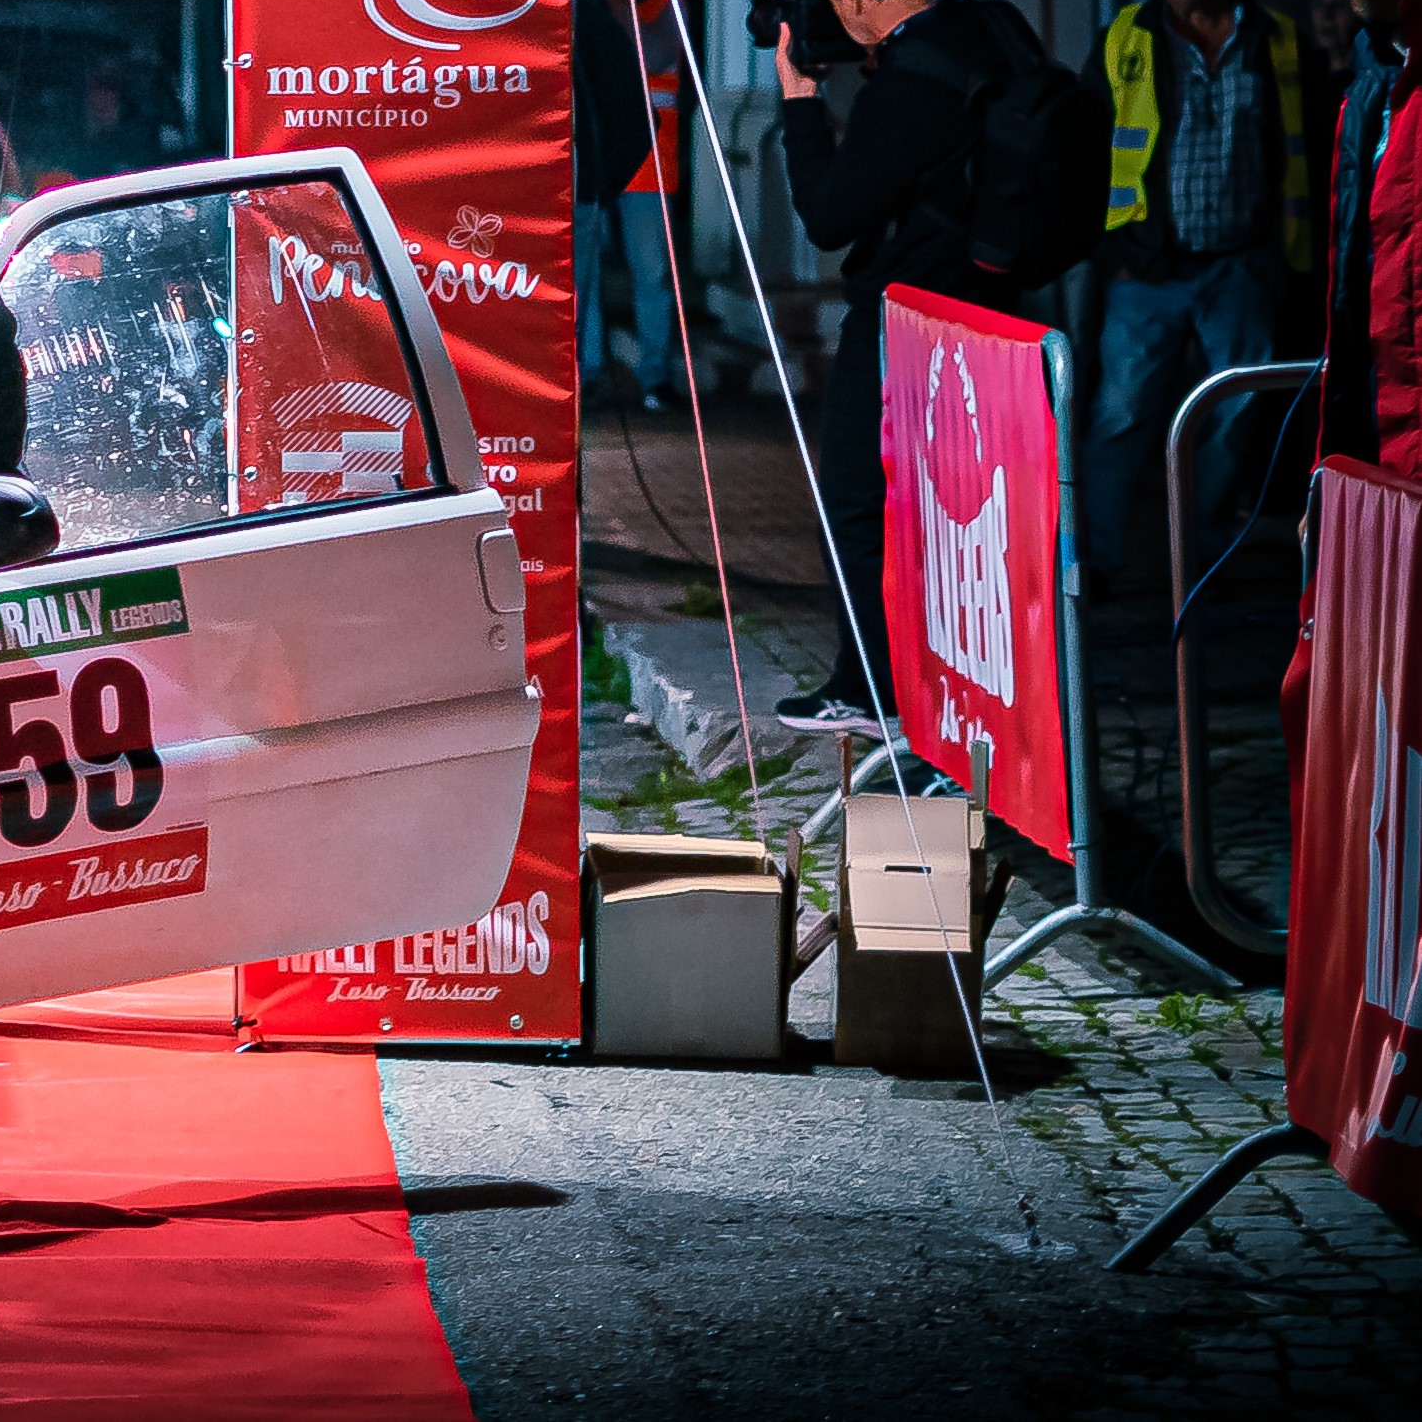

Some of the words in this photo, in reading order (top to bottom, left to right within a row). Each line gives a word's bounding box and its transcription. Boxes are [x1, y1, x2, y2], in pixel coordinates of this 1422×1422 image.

[267, 56, 531, 109] mortágua
[284, 103, 429, 129] MUNICÍPIO
[268, 234, 541, 305] Penova
[0, 588, 102, 649] RALLY
[110, 599, 183, 633] LEGENDS
[67, 854, 203, 903] Bussaco
[326, 977, 391, 1002] Luso
[405, 977, 502, 1001] Bussaco
